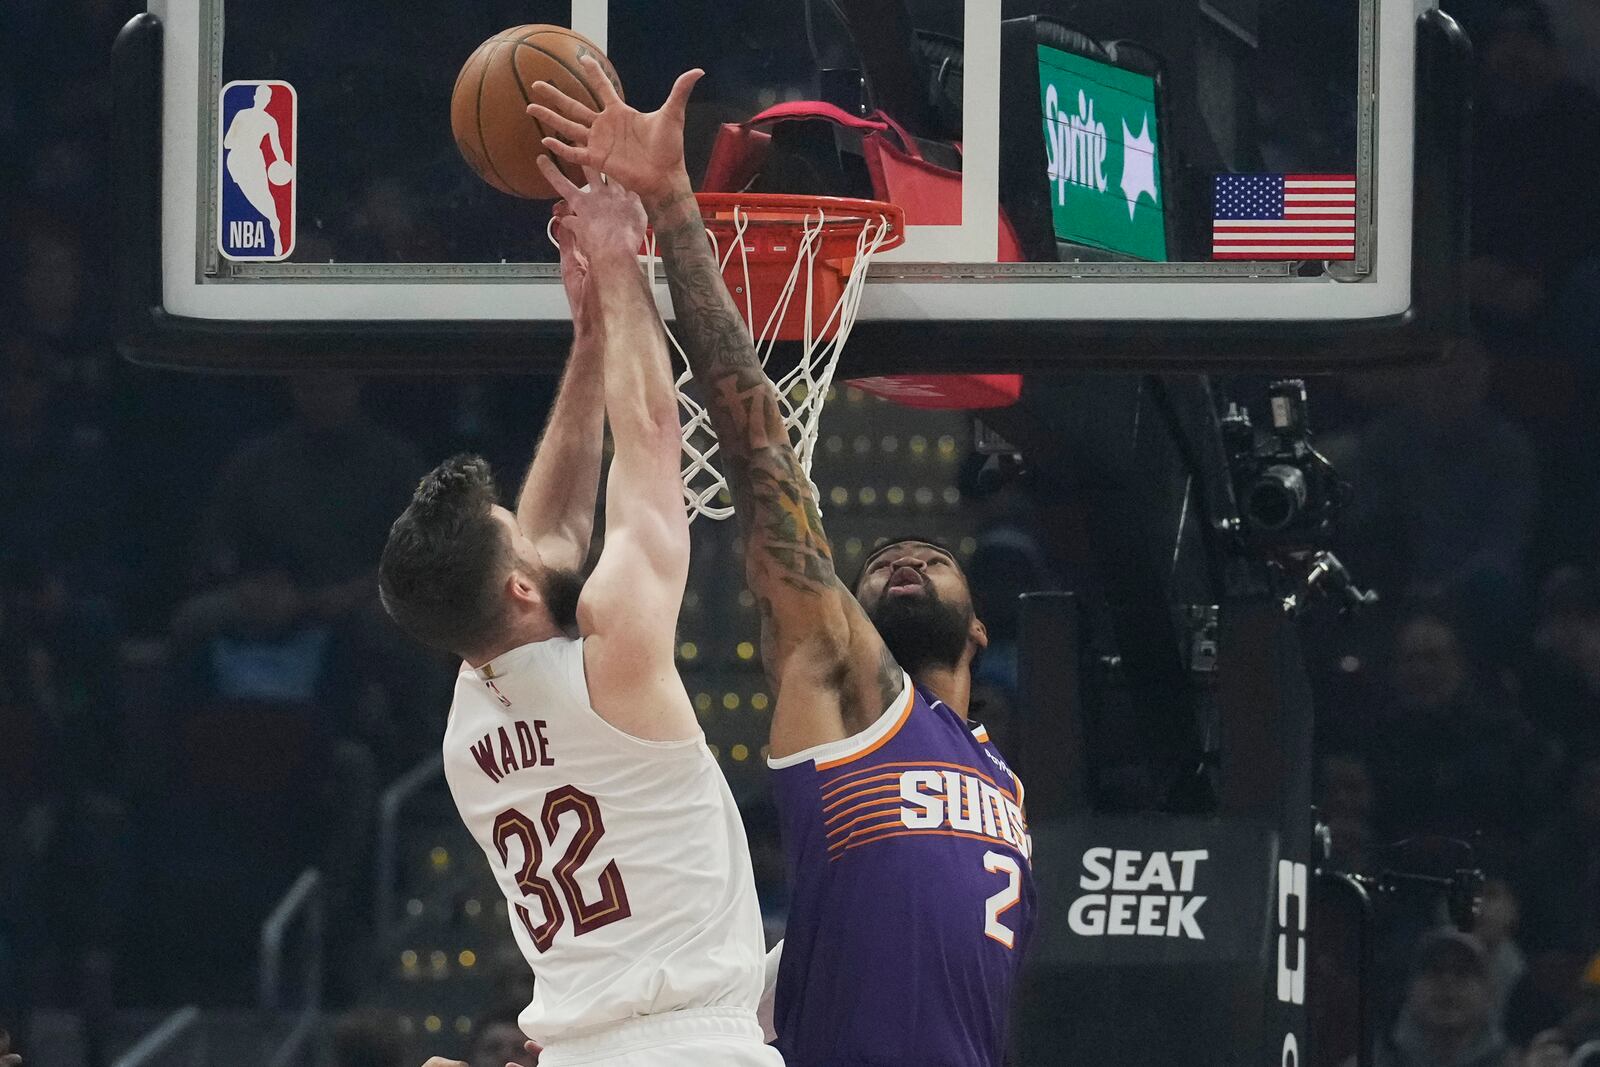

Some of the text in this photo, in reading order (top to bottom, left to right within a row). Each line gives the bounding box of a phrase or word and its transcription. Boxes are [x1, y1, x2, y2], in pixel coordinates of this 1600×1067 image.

[1045, 83, 1108, 206] Sprite
[229, 220, 266, 248] NBA
[469, 719, 555, 784] WADE
[492, 784, 632, 954] 32
[982, 849, 1022, 950] 2
[1079, 846, 1209, 892] SEAT
[1067, 893, 1208, 940] GEEK
